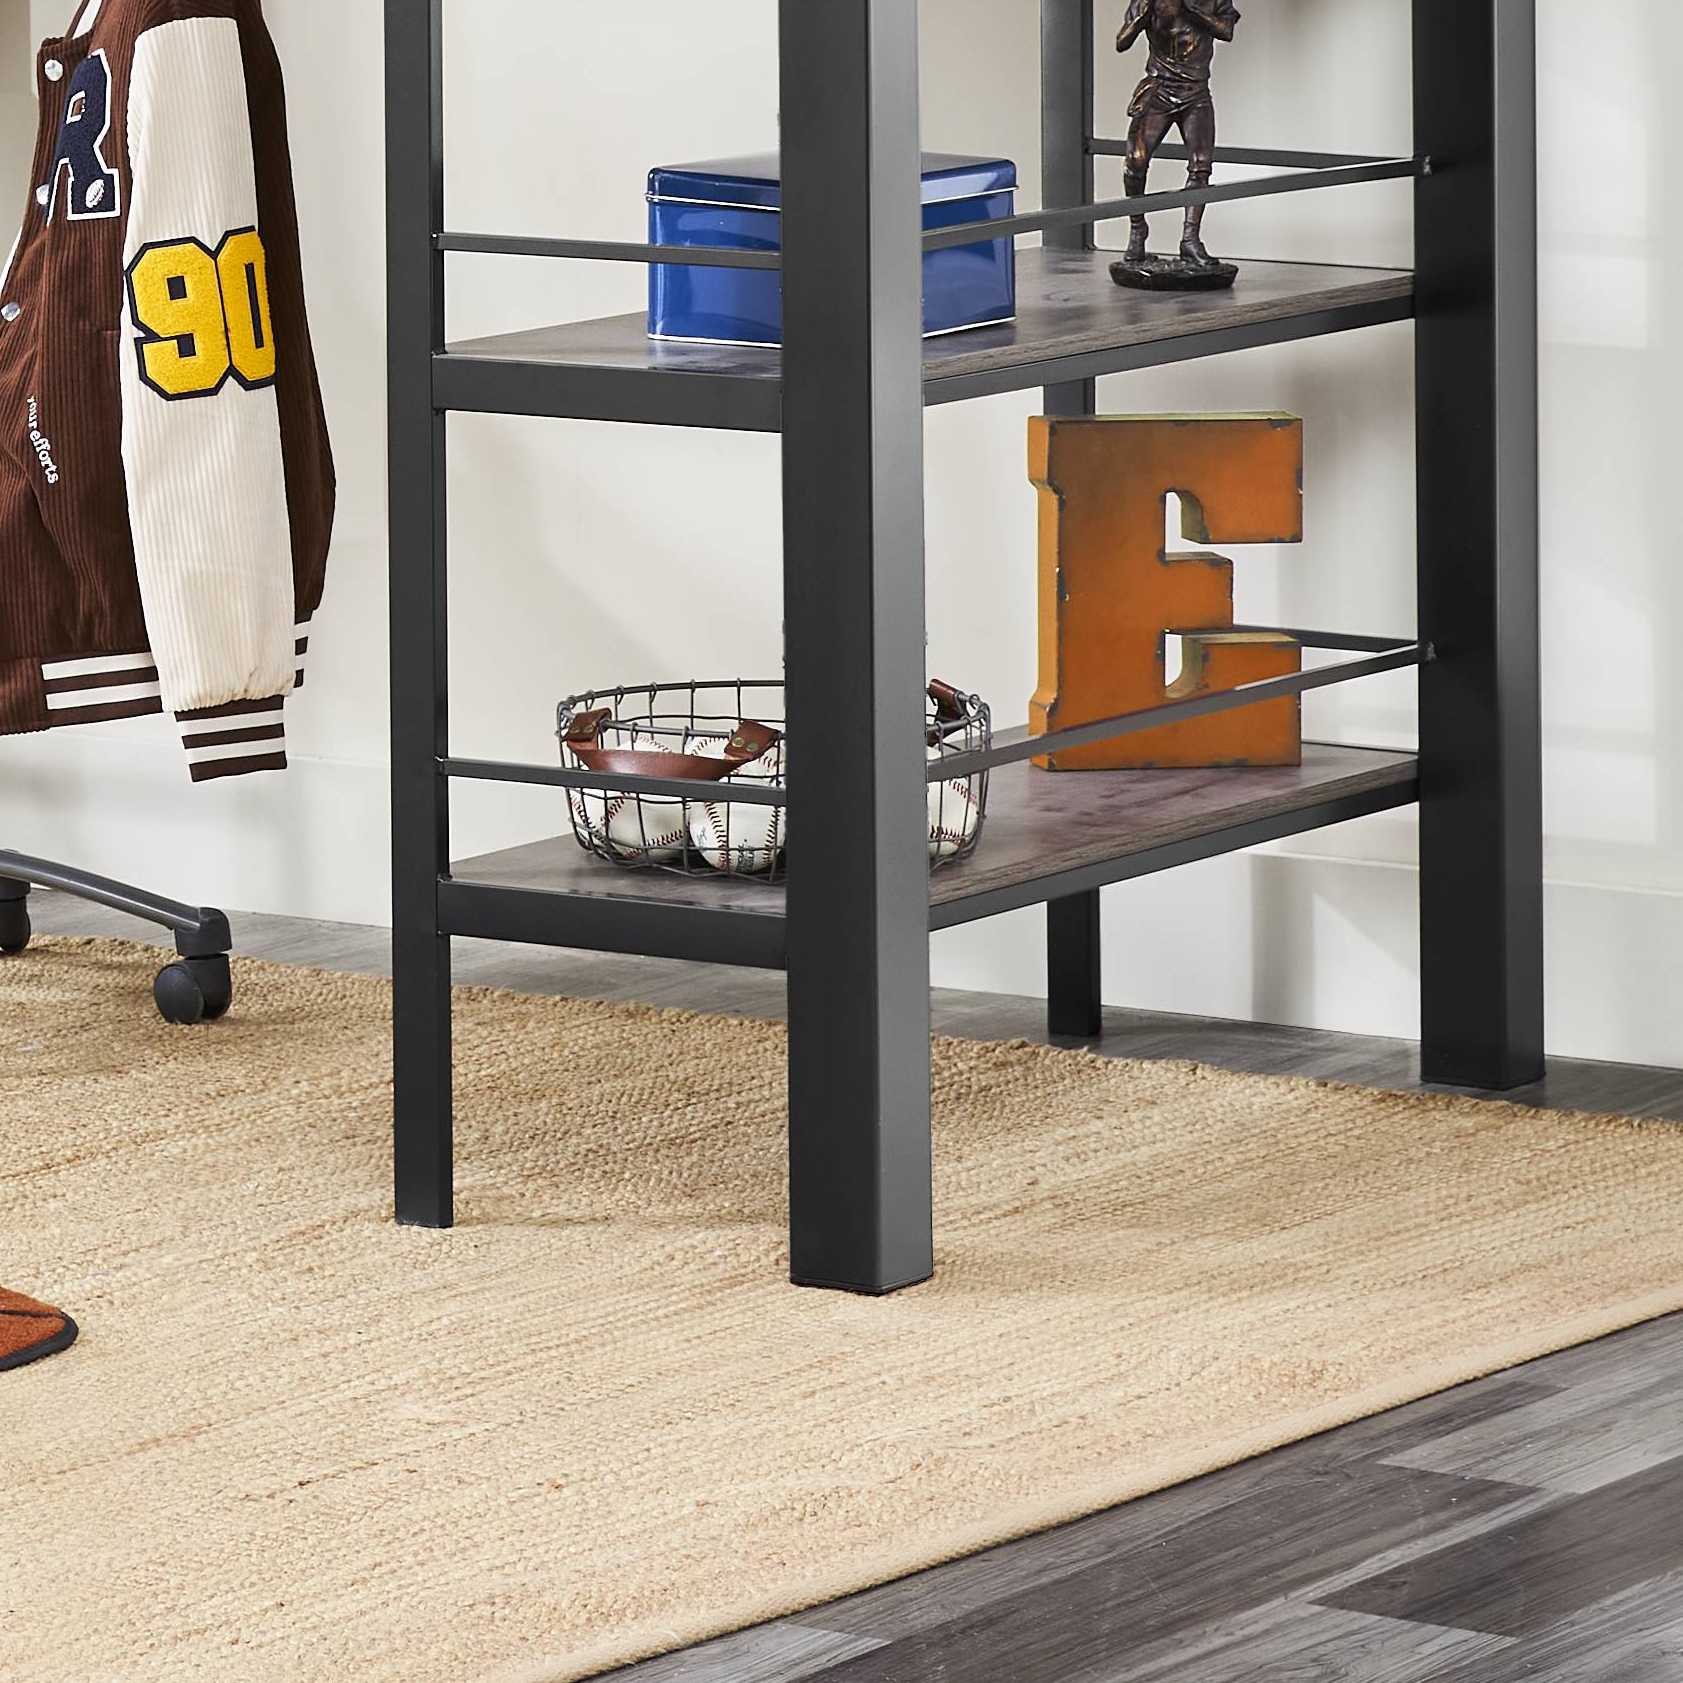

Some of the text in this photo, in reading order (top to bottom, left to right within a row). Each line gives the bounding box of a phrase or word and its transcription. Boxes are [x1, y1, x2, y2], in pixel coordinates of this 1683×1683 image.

[44, 48, 121, 227] R
[124, 225, 275, 401] 90
[27, 396, 59, 484] your efforts
[1029, 411, 1303, 771] E
